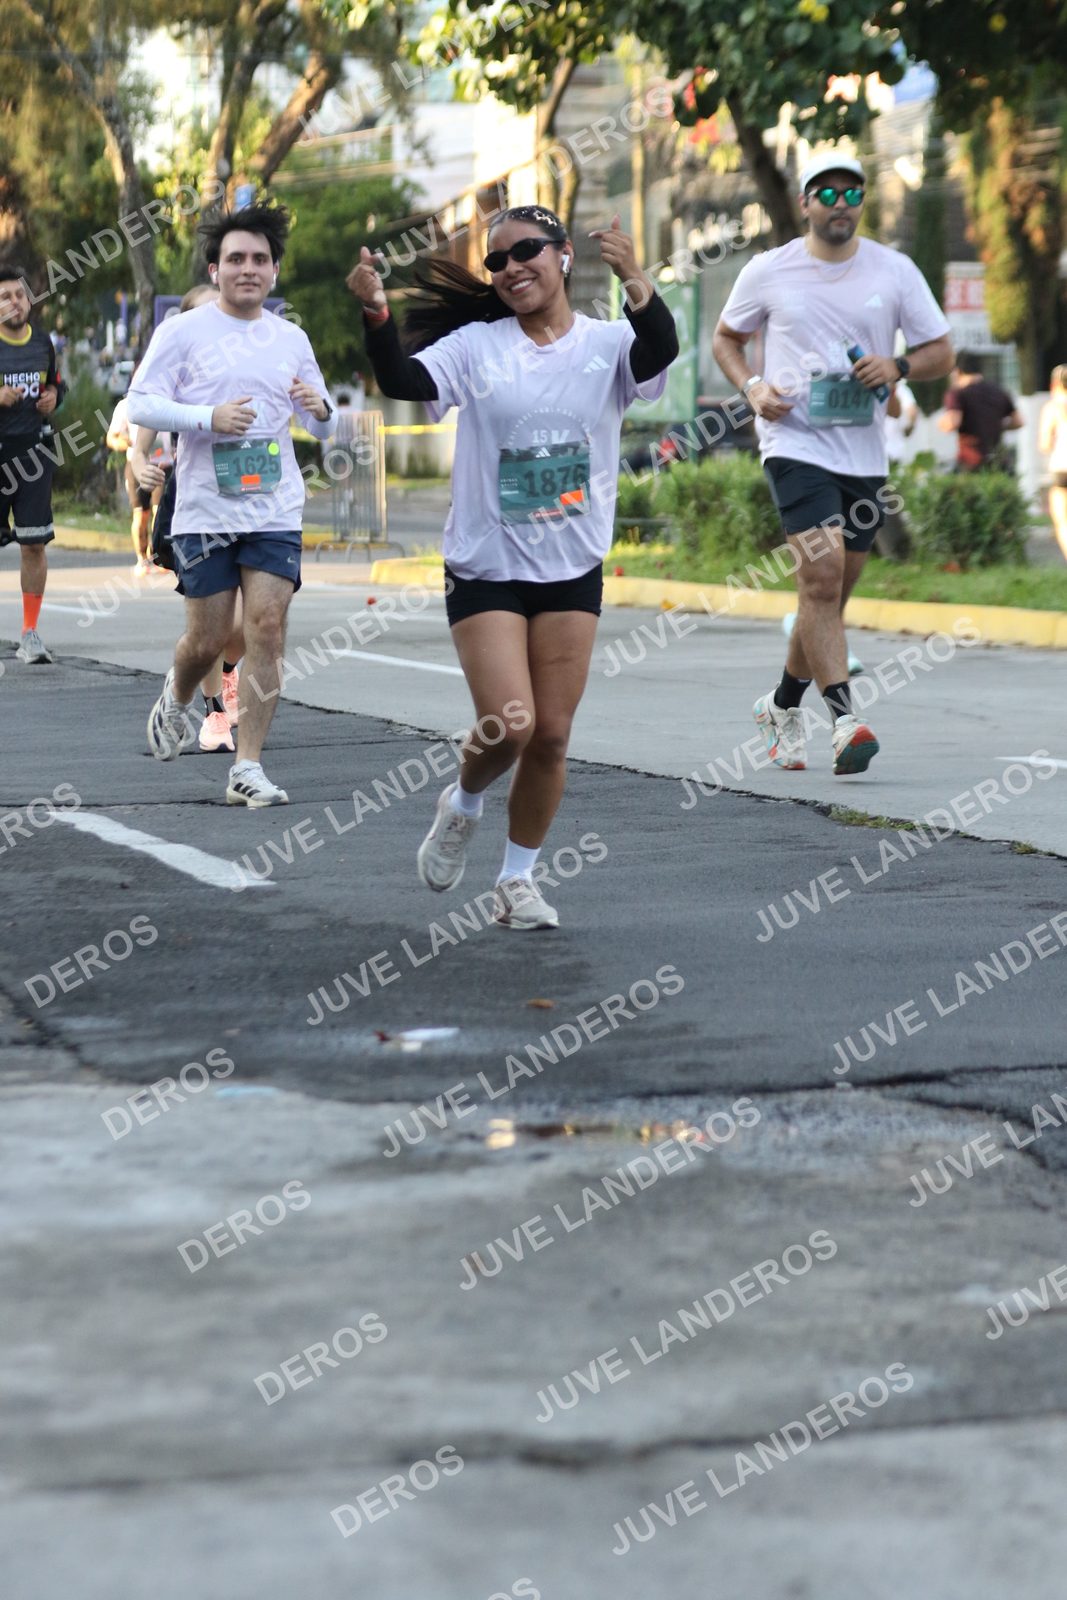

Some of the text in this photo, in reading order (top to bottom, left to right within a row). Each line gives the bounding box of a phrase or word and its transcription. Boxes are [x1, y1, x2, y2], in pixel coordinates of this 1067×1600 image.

[4, 371, 40, 384] HECHO
[233, 454, 280, 477] 1625
[523, 463, 587, 498] 1876
